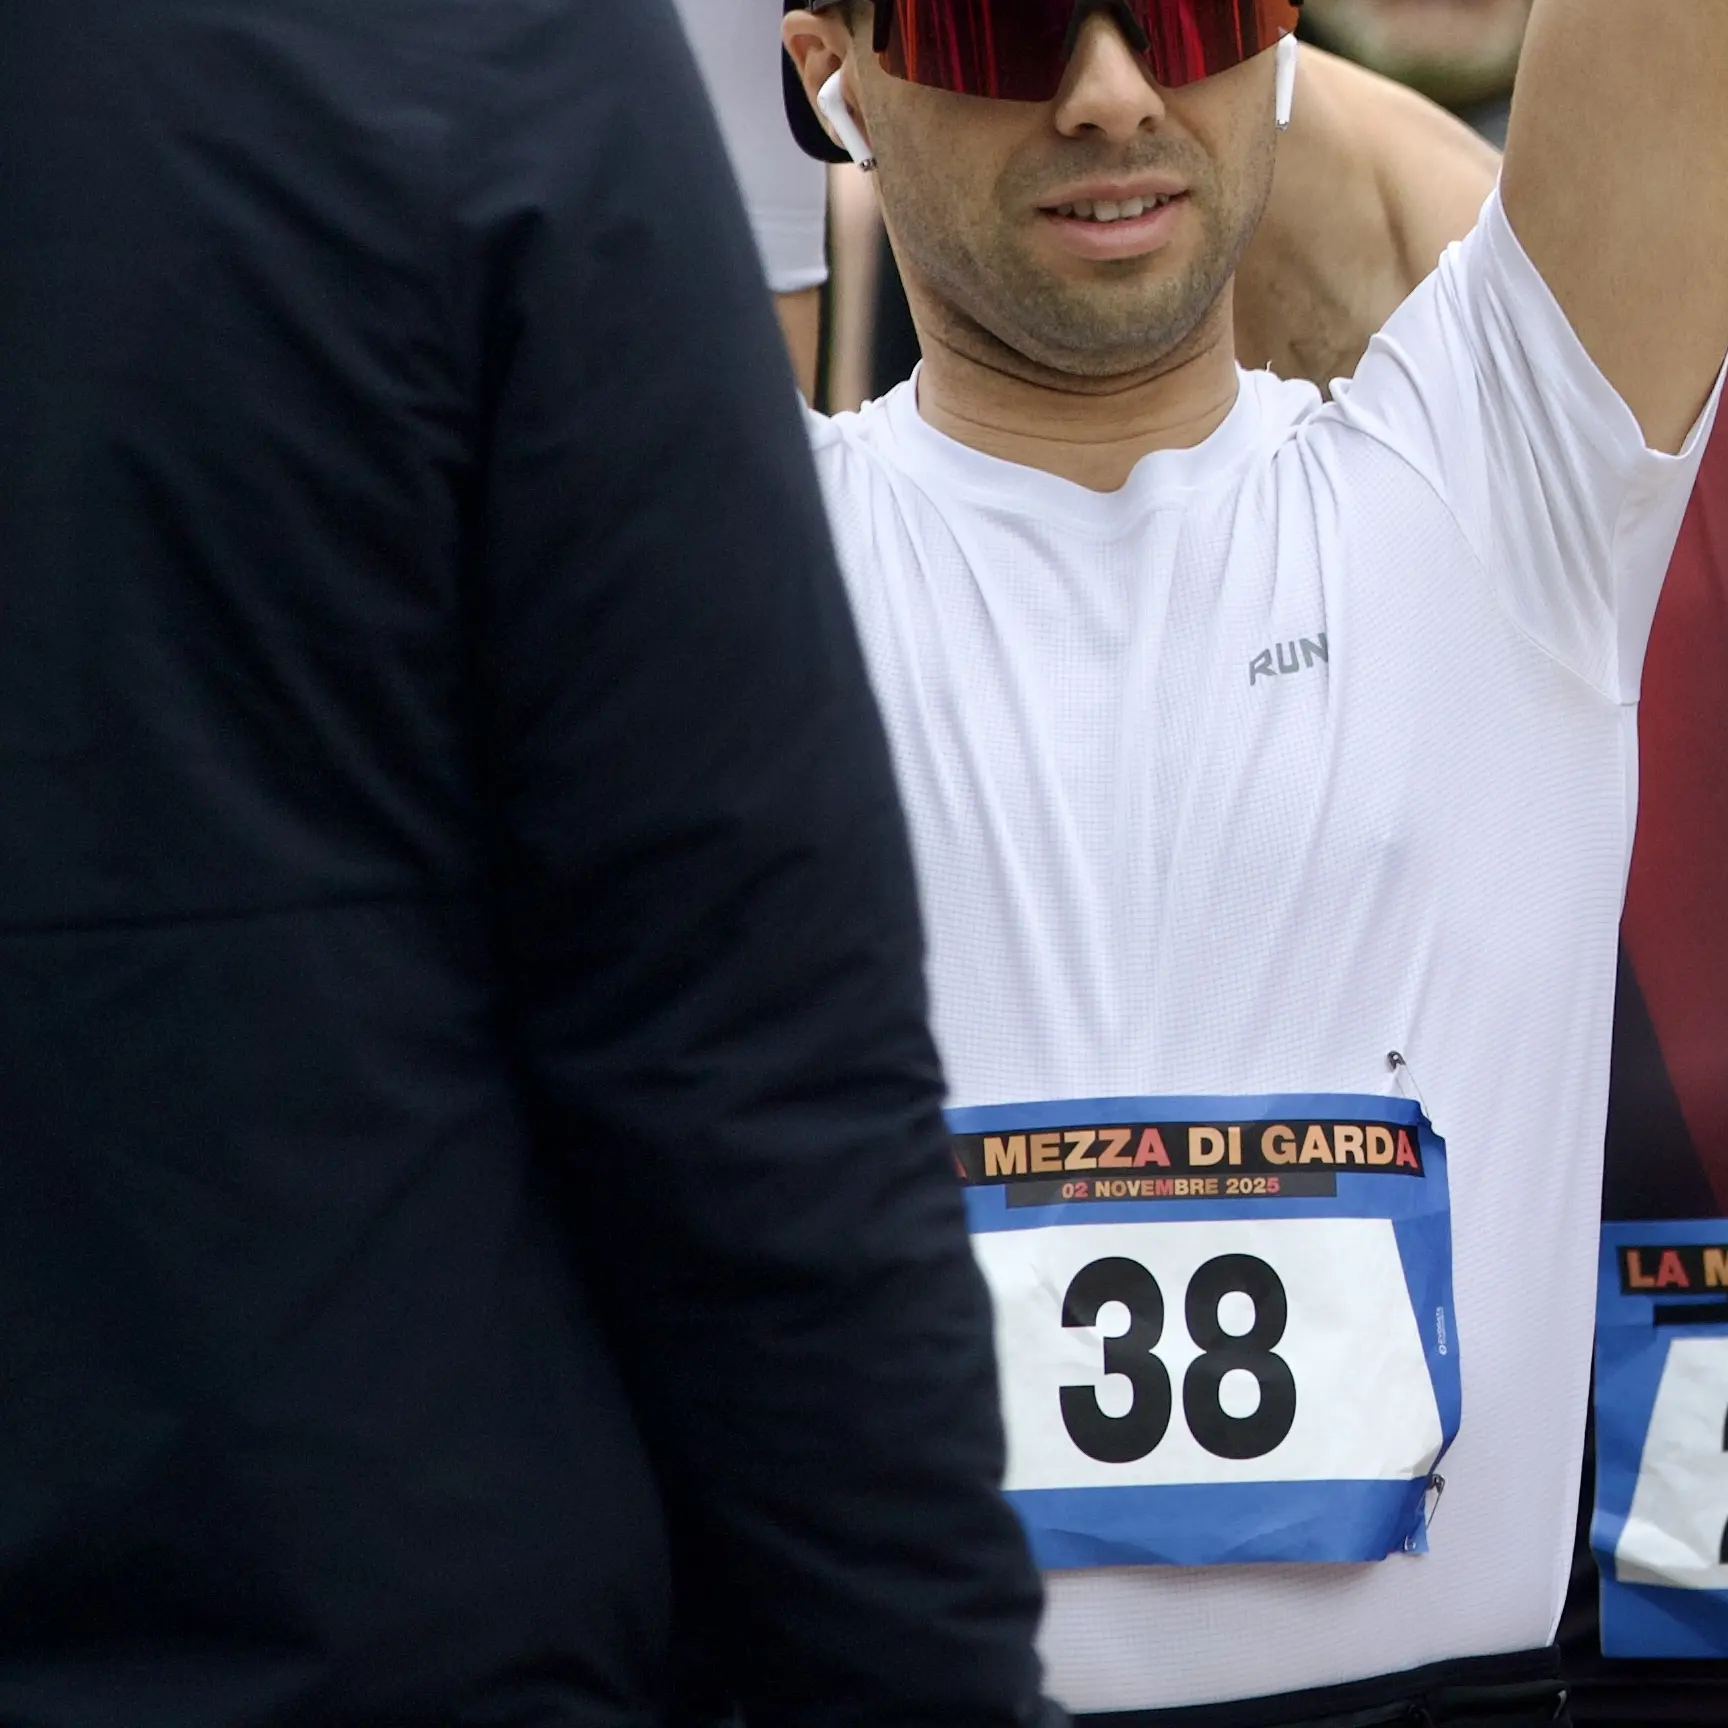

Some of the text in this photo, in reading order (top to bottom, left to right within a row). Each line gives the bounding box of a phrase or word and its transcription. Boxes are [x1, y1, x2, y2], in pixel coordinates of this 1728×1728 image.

[1249, 631, 1329, 687] RUN
[983, 1127, 1172, 1177] MEZZA
[1188, 1126, 1242, 1168] DI
[1260, 1125, 1420, 1170] GARDA
[1061, 1176, 1281, 1200] 02 NOVEMBRE 2025
[1624, 1248, 1690, 1289] LA
[1058, 1252, 1298, 1465] 38
